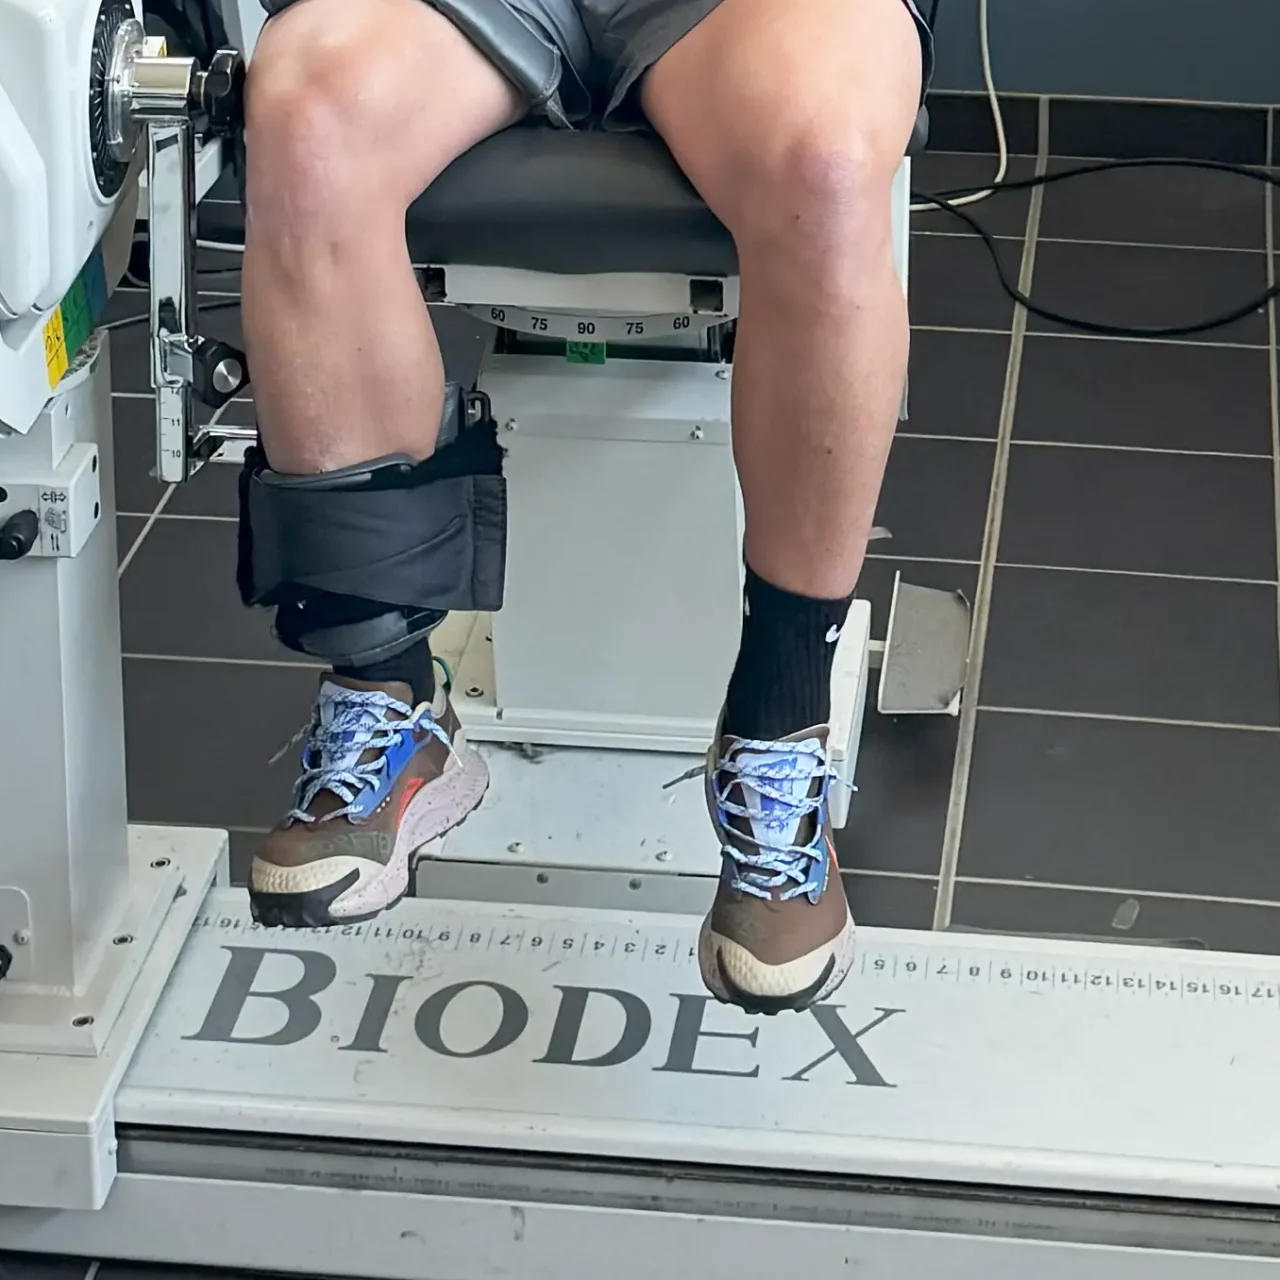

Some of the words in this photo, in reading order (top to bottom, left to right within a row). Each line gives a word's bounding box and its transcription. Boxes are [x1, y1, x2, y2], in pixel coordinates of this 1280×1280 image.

[491, 307, 505, 323] 60
[531, 317, 548, 331] 75
[577, 322, 595, 334] 90
[626, 322, 644, 335] 75
[673, 316, 690, 330] 60
[171, 418, 180, 426] 11
[172, 449, 181, 458] 10
[220, 919, 241, 929] 16
[374, 927, 392, 938] 11
[403, 929, 423, 939] 10
[438, 930, 450, 941] 9
[469, 932, 481, 943] 8
[499, 934, 511, 945] 7
[531, 936, 543, 947] 6
[563, 938, 574, 950] 5
[593, 940, 605, 951] 4
[624, 942, 638, 953] 3
[655, 944, 667, 955] 2
[873, 959, 885, 970] 5
[905, 961, 917, 972] 6
[936, 964, 948, 974] 7
[1000, 968, 1012, 979] 9
[1026, 970, 1049, 981] 10
[1061, 972, 1081, 984] 11
[1090, 974, 1113, 986] 12
[1122, 977, 1145, 988] 13
[1155, 980, 1177, 991] 14
[1187, 982, 1210, 993] 15
[1219, 984, 1242, 996] 16
[1251, 987, 1275, 998] 17
[181, 944, 907, 1088] BIODEX
